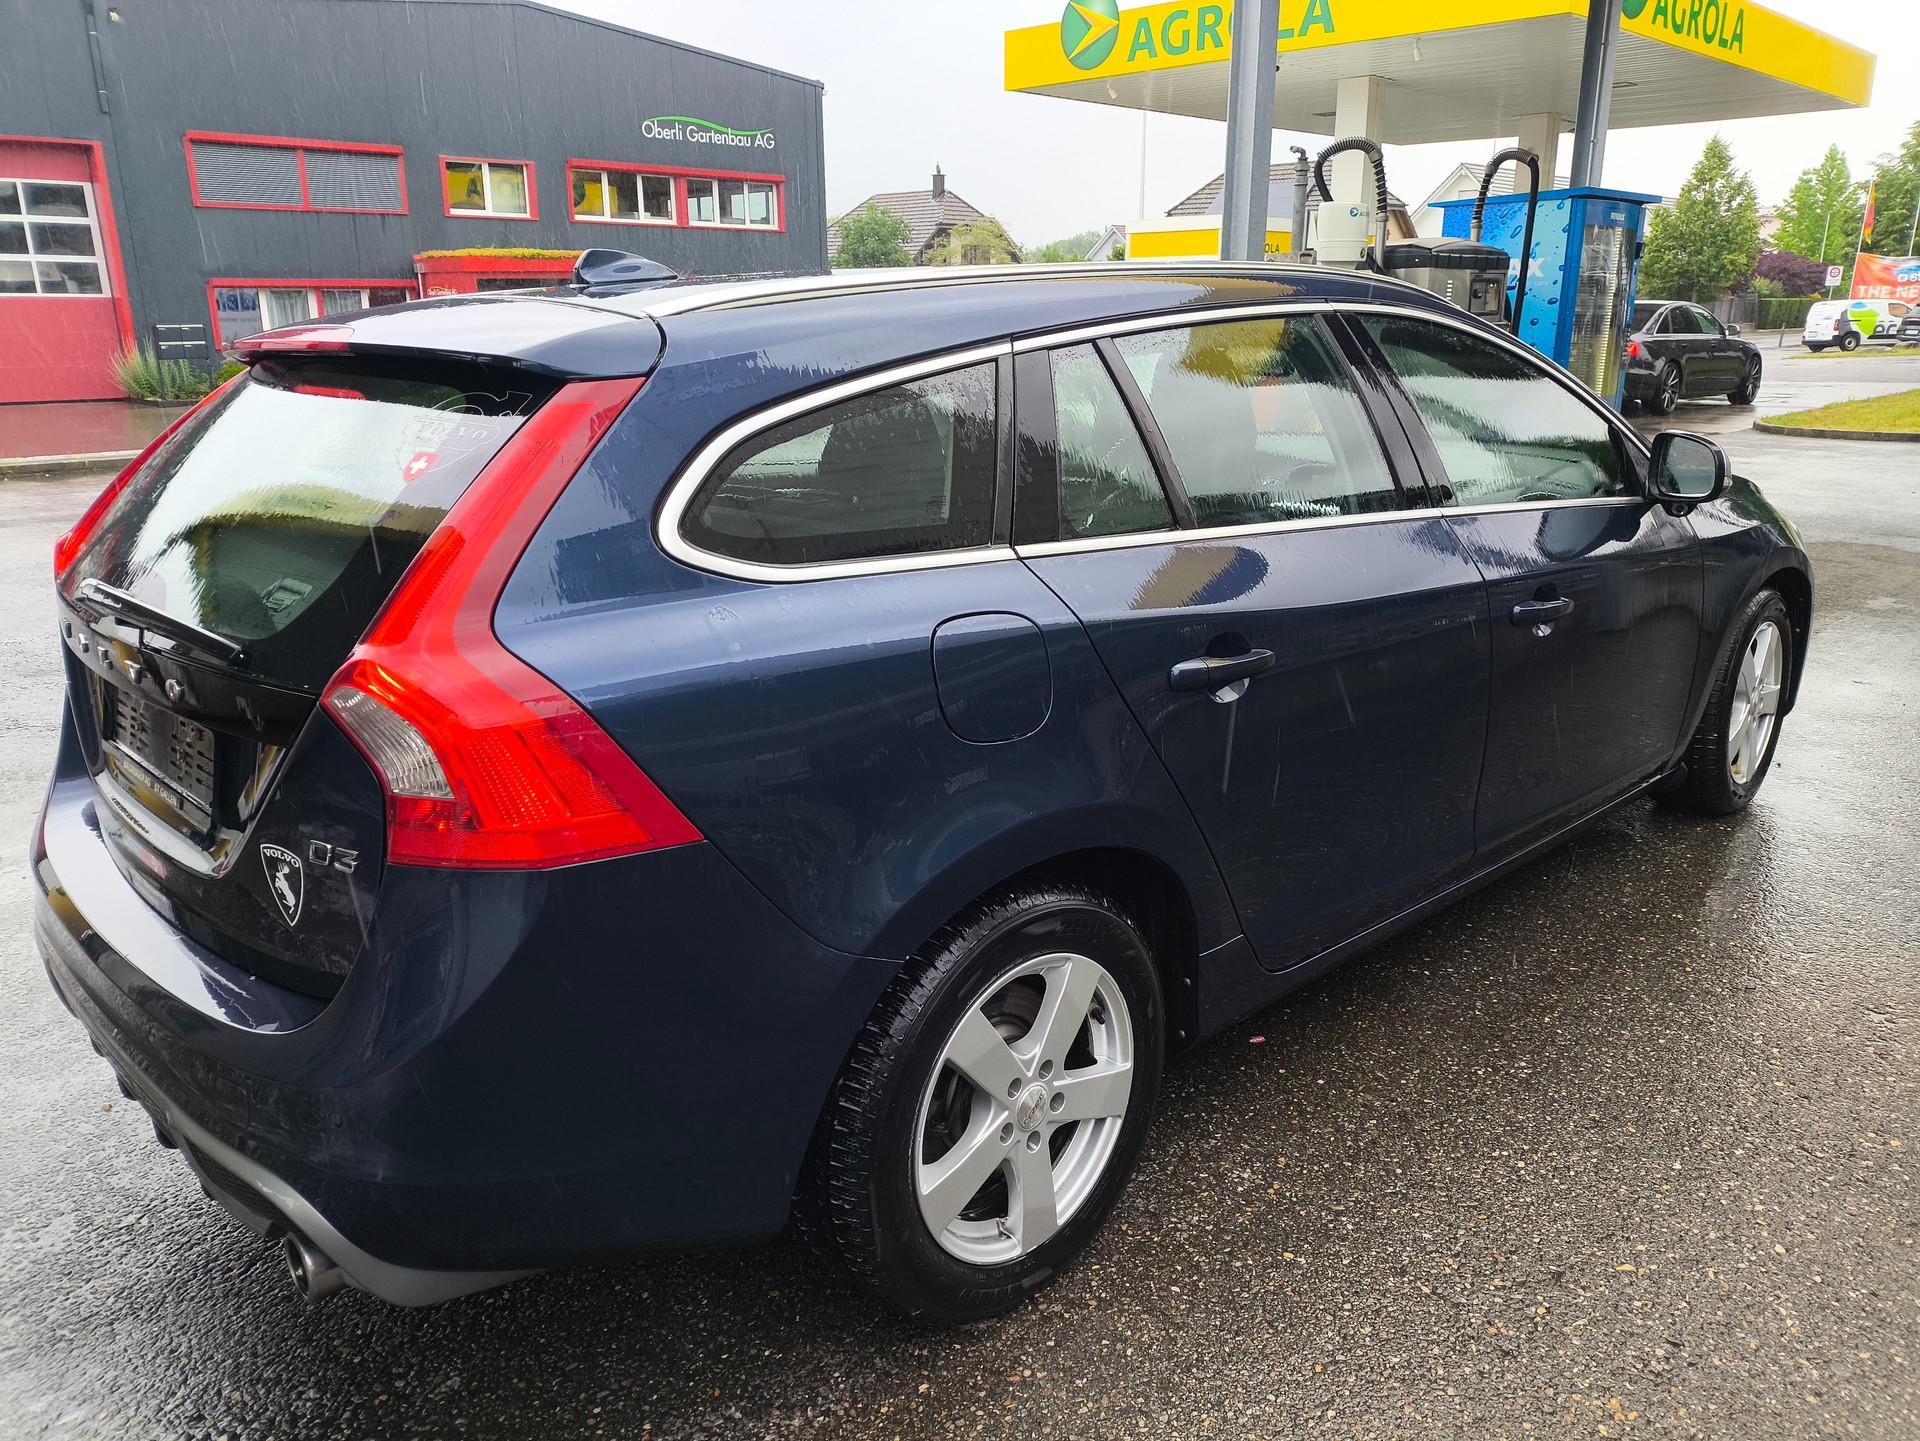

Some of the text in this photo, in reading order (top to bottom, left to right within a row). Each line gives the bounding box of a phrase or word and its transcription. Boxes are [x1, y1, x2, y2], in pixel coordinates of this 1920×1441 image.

[1127, 0, 1335, 62] AGRA
[1651, 0, 1744, 54] AGROLA
[641, 119, 775, 149] Oberli Gartenbau AG
[1857, 285, 1892, 298] THE
[263, 848, 300, 869] VOLVO
[309, 840, 359, 874] D3
